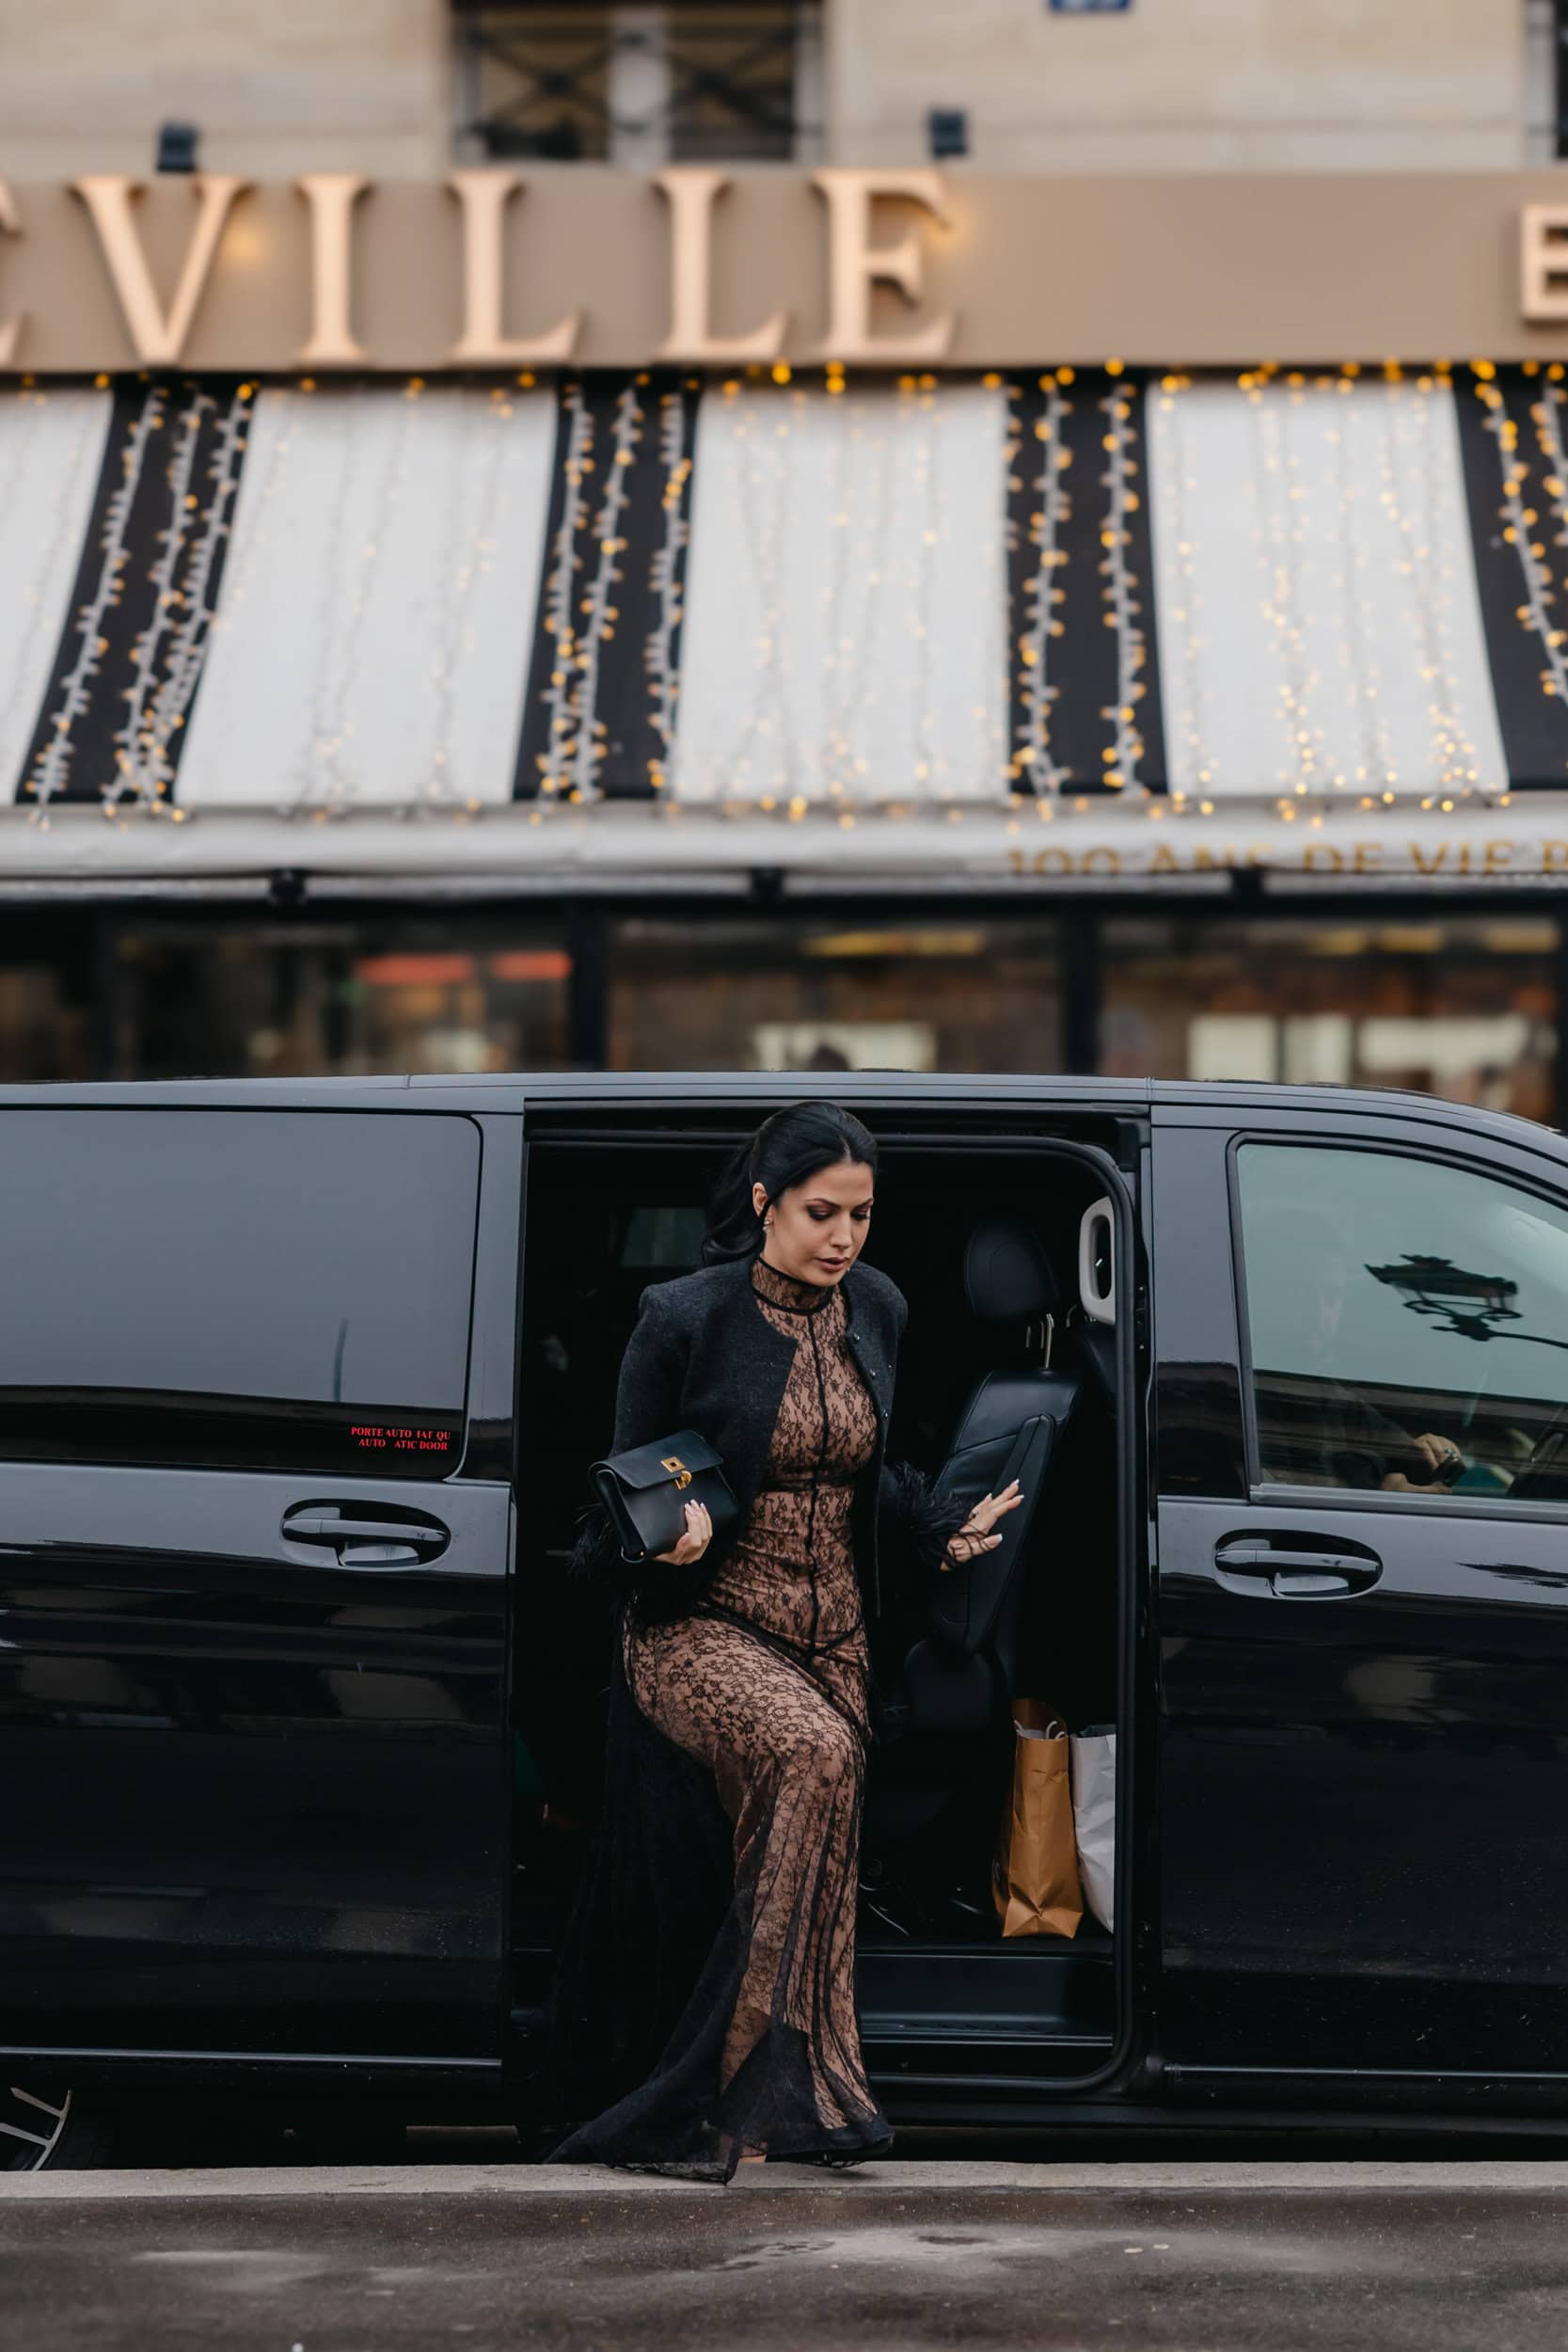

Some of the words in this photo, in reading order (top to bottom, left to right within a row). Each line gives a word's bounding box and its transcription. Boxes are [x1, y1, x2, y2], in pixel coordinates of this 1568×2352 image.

[0, 171, 953, 367] VILLE
[351, 1426, 384, 1437] PORTE
[419, 1441, 448, 1451] DOOR
